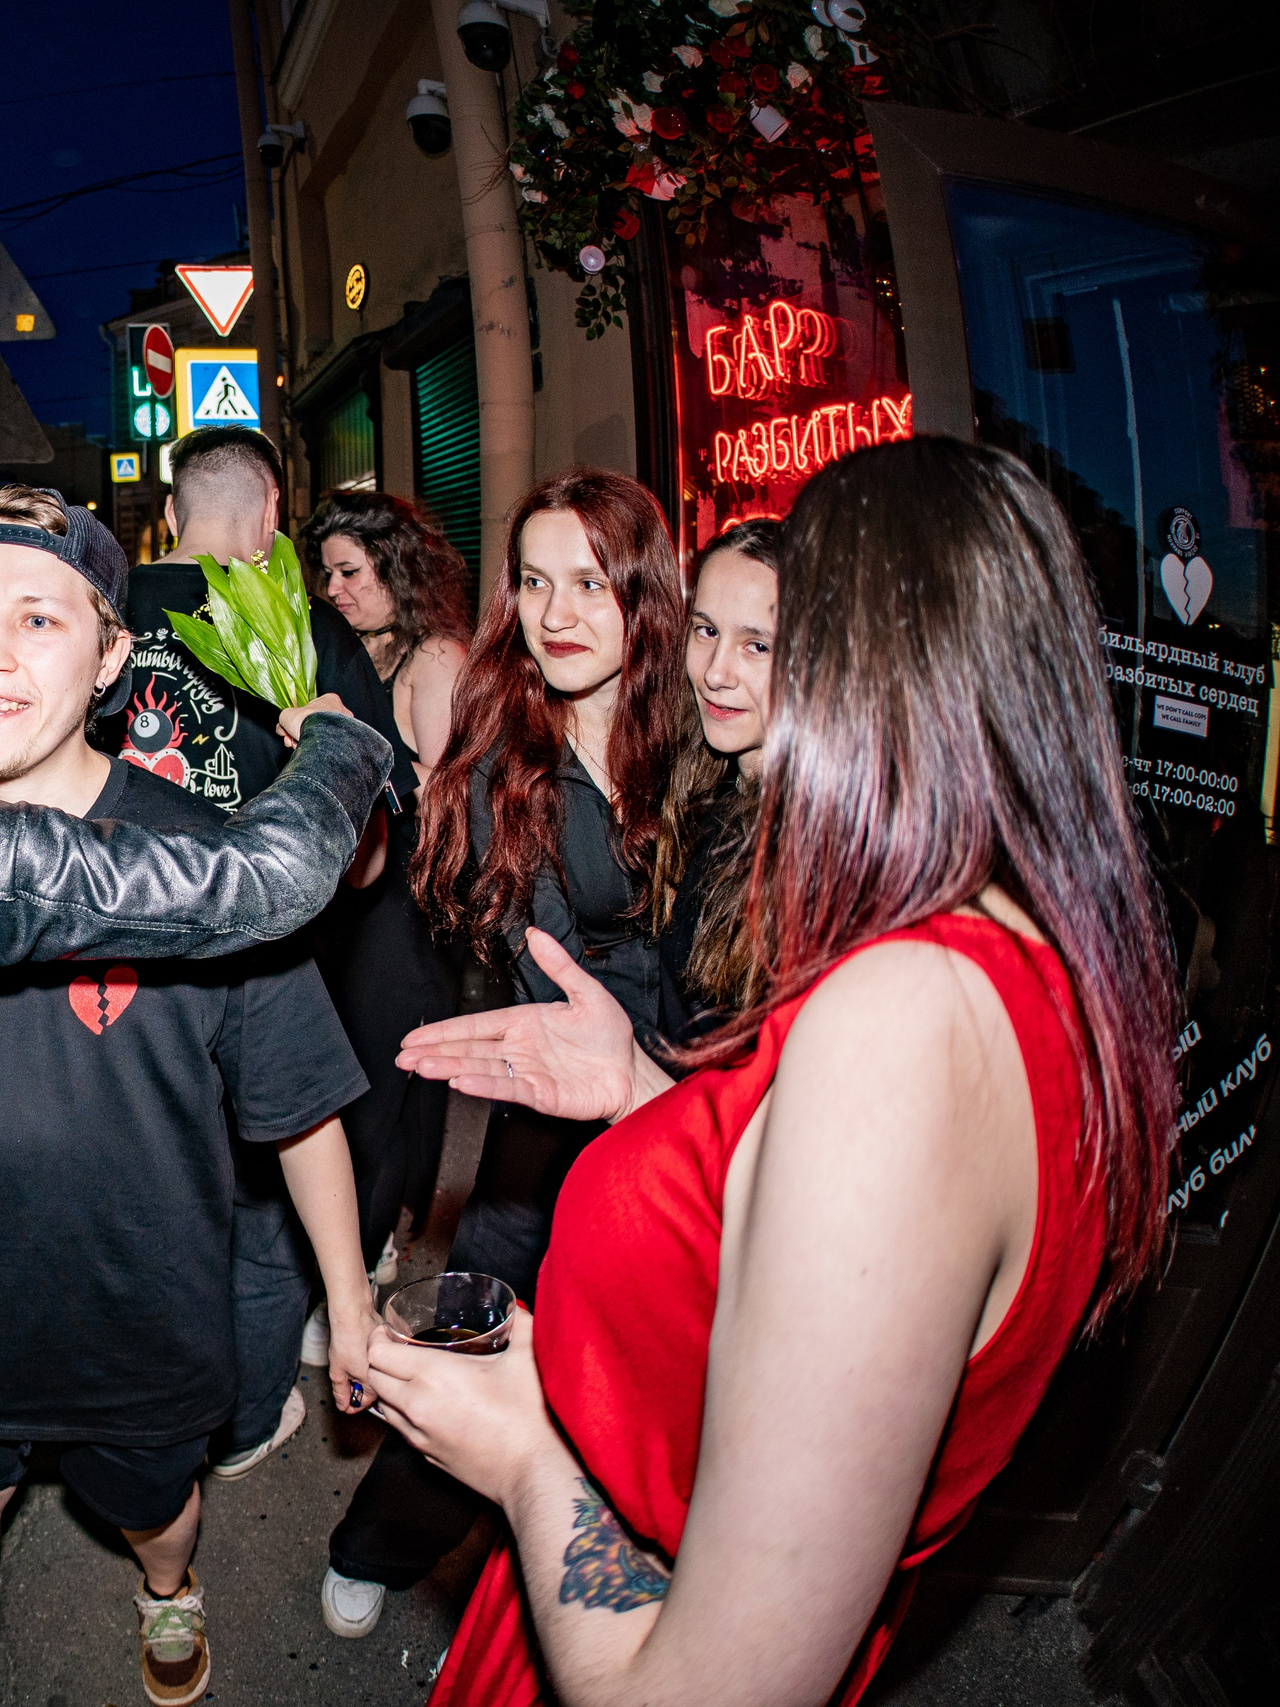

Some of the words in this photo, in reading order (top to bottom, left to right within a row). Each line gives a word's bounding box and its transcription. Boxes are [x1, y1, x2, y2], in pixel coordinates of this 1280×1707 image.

[705, 301, 795, 394] БАР
[714, 394, 913, 482] РАЗБИТЫХ
[1222, 659, 1266, 685] клуб
[1157, 703, 1165, 711] WE
[1165, 706, 1182, 714] DON'T
[1182, 709, 1194, 717] CALL
[1194, 712, 1207, 720] COPS
[1199, 685, 1260, 718] сердец
[140, 715, 150, 728] 8
[1170, 715, 1182, 723] CALL
[1182, 718, 1201, 727] FAMILY
[203, 776, 232, 798] love
[1157, 760, 1239, 793] 17:00-00:00
[1153, 783, 1236, 817] 17:00-02:00
[1219, 1032, 1273, 1099] клуб
